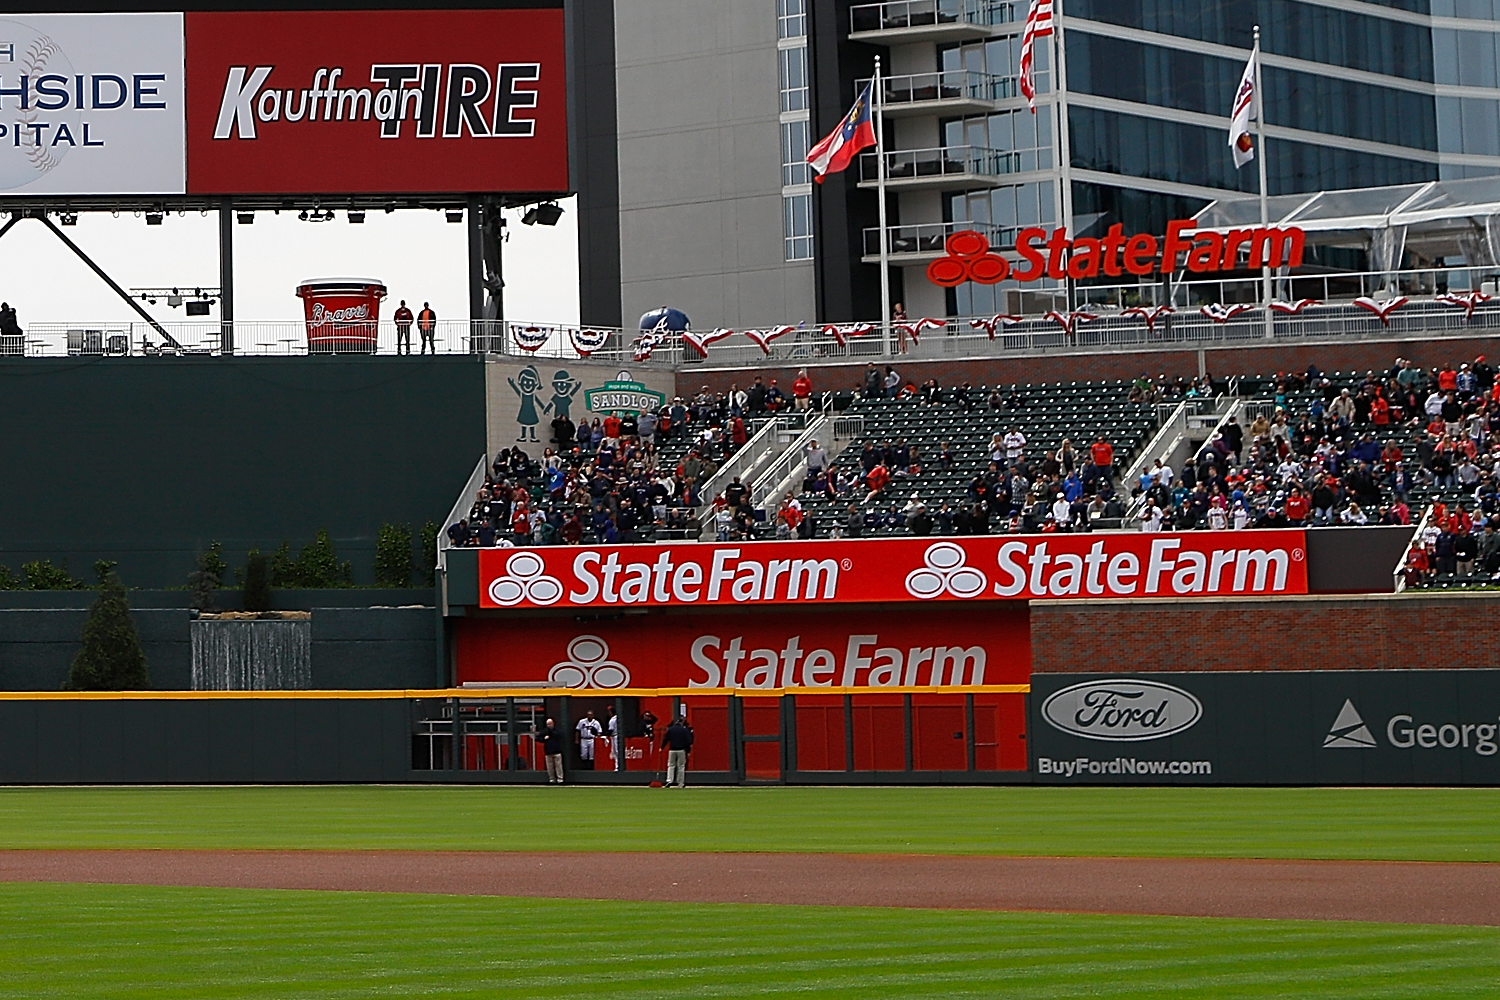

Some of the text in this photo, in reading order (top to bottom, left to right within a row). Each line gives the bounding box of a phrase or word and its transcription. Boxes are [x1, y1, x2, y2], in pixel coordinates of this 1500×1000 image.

[213, 62, 542, 140] Kauffman TIRE
[1012, 219, 1306, 282] State Farm
[592, 394, 658, 410] SANDLOT
[569, 548, 839, 604] State Farm
[994, 538, 1289, 596] State Farm
[688, 634, 987, 689] State Farm
[1075, 689, 1168, 728] Ford
[1387, 714, 1500, 756] Georg
[1038, 757, 1212, 777] BuyFordNow.com
